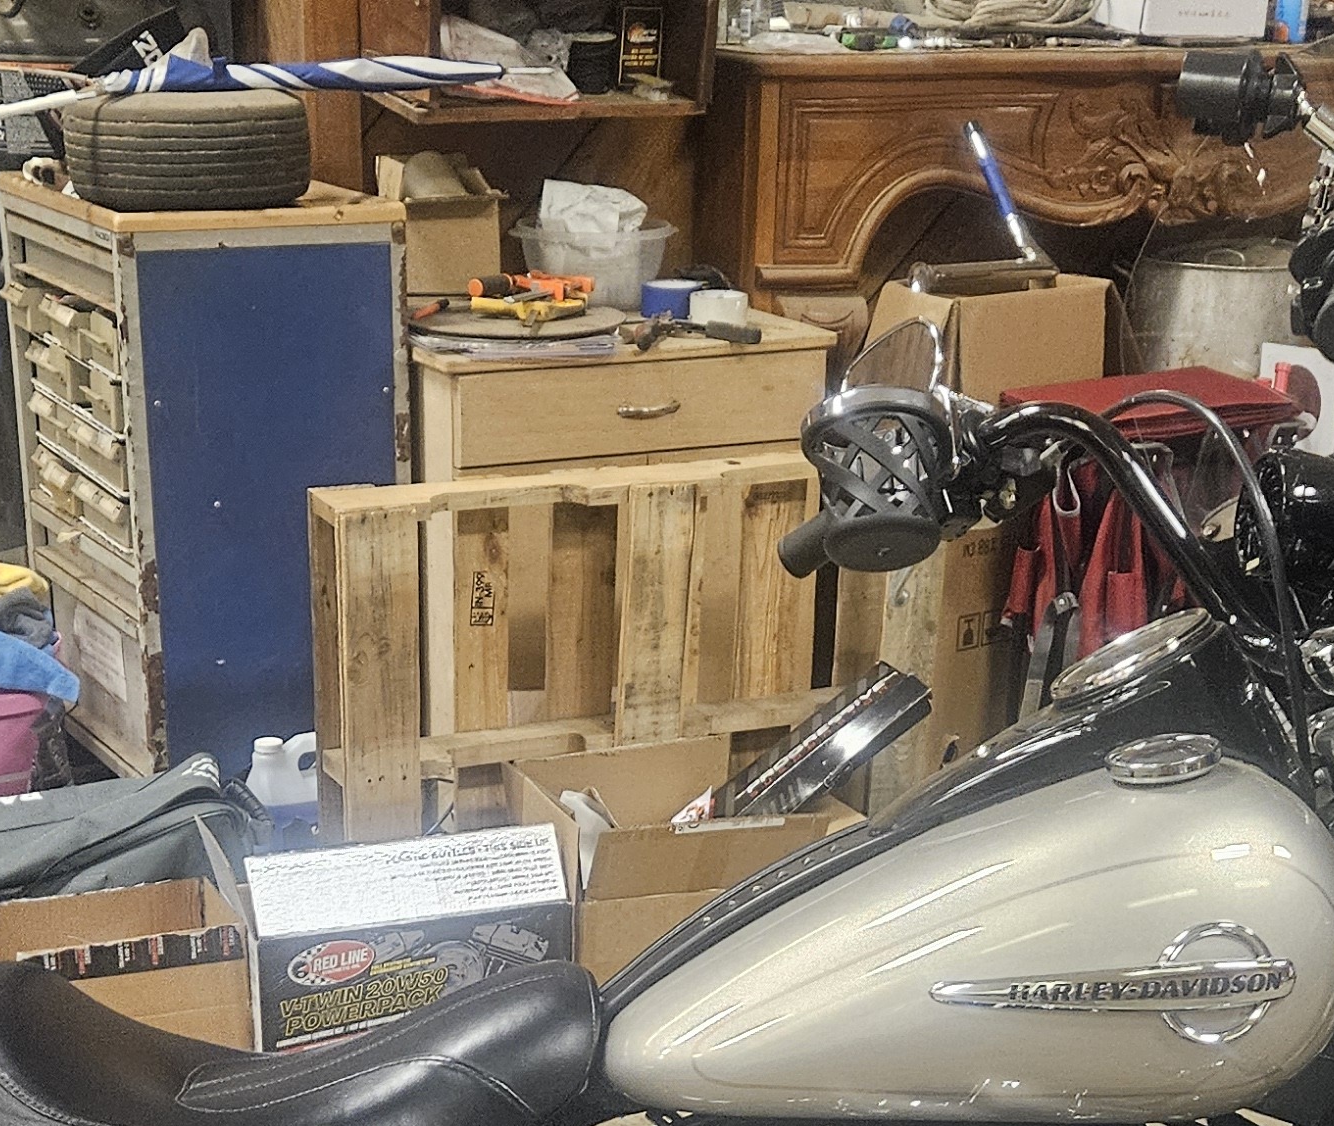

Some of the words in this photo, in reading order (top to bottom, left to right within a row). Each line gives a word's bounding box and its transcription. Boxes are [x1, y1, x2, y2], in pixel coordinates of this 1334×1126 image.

[313, 956, 338, 973] RED
[340, 948, 368, 967] LINE
[280, 984, 363, 1018] V-TWIN
[365, 966, 449, 1000] 20W50
[1009, 972, 1283, 1001] HARLEY-DAVIDSON
[285, 984, 443, 1037] POWERPACK
